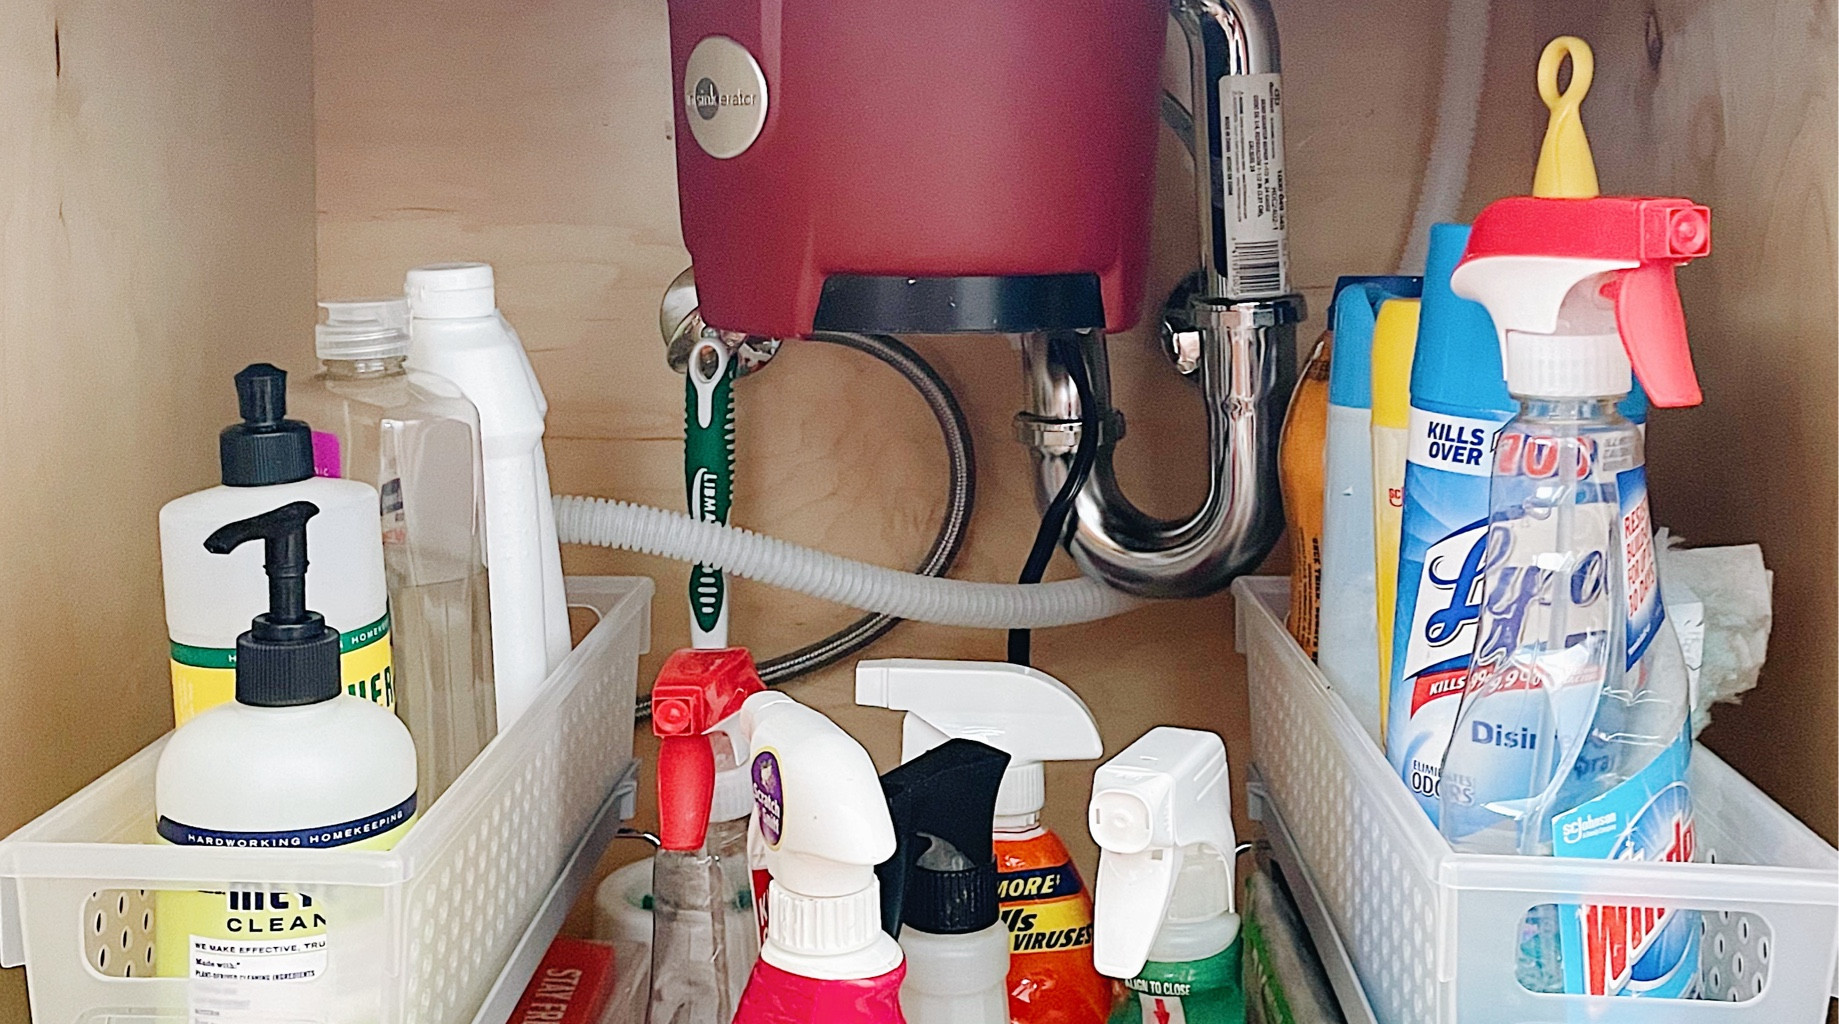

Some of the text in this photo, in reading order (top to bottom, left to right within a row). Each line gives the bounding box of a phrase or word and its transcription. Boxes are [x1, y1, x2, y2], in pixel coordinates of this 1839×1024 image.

[1427, 421, 1485, 446] KILLS
[1428, 442, 1483, 466] OVER
[1429, 679, 1466, 696] KILLS
[187, 810, 403, 847] HARDWORKING HOMEKEEPING
[209, 945, 236, 953] MAKE
[535, 968, 582, 1000] STAY
[1149, 981, 1162, 994] TO
[1163, 982, 1191, 995] CLOSE
